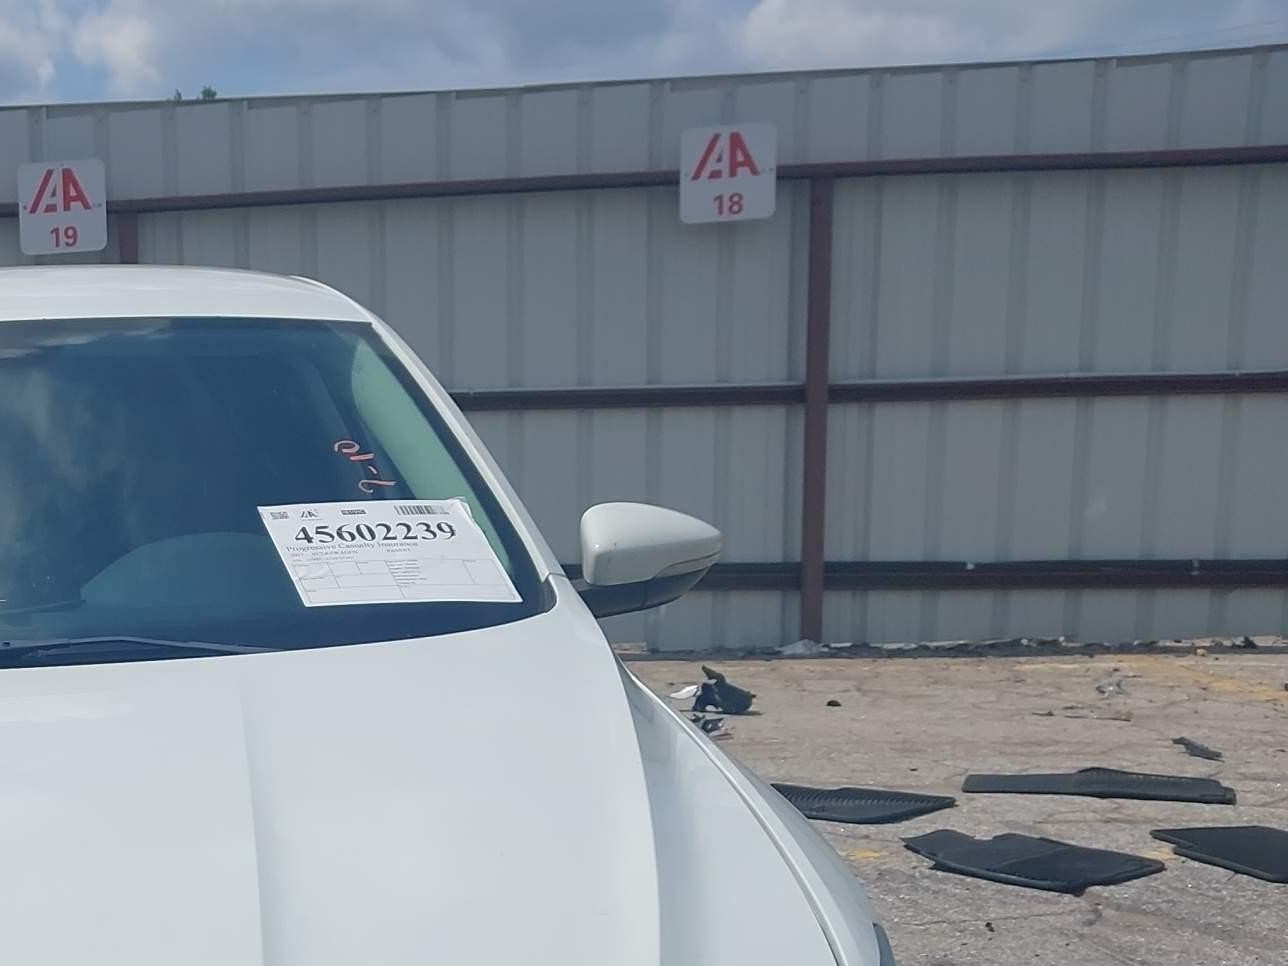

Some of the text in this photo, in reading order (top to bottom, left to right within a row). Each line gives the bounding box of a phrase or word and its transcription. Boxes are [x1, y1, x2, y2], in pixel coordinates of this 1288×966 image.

[713, 192, 744, 215] 18
[49, 225, 78, 248] 19
[294, 521, 457, 544] 45602239
